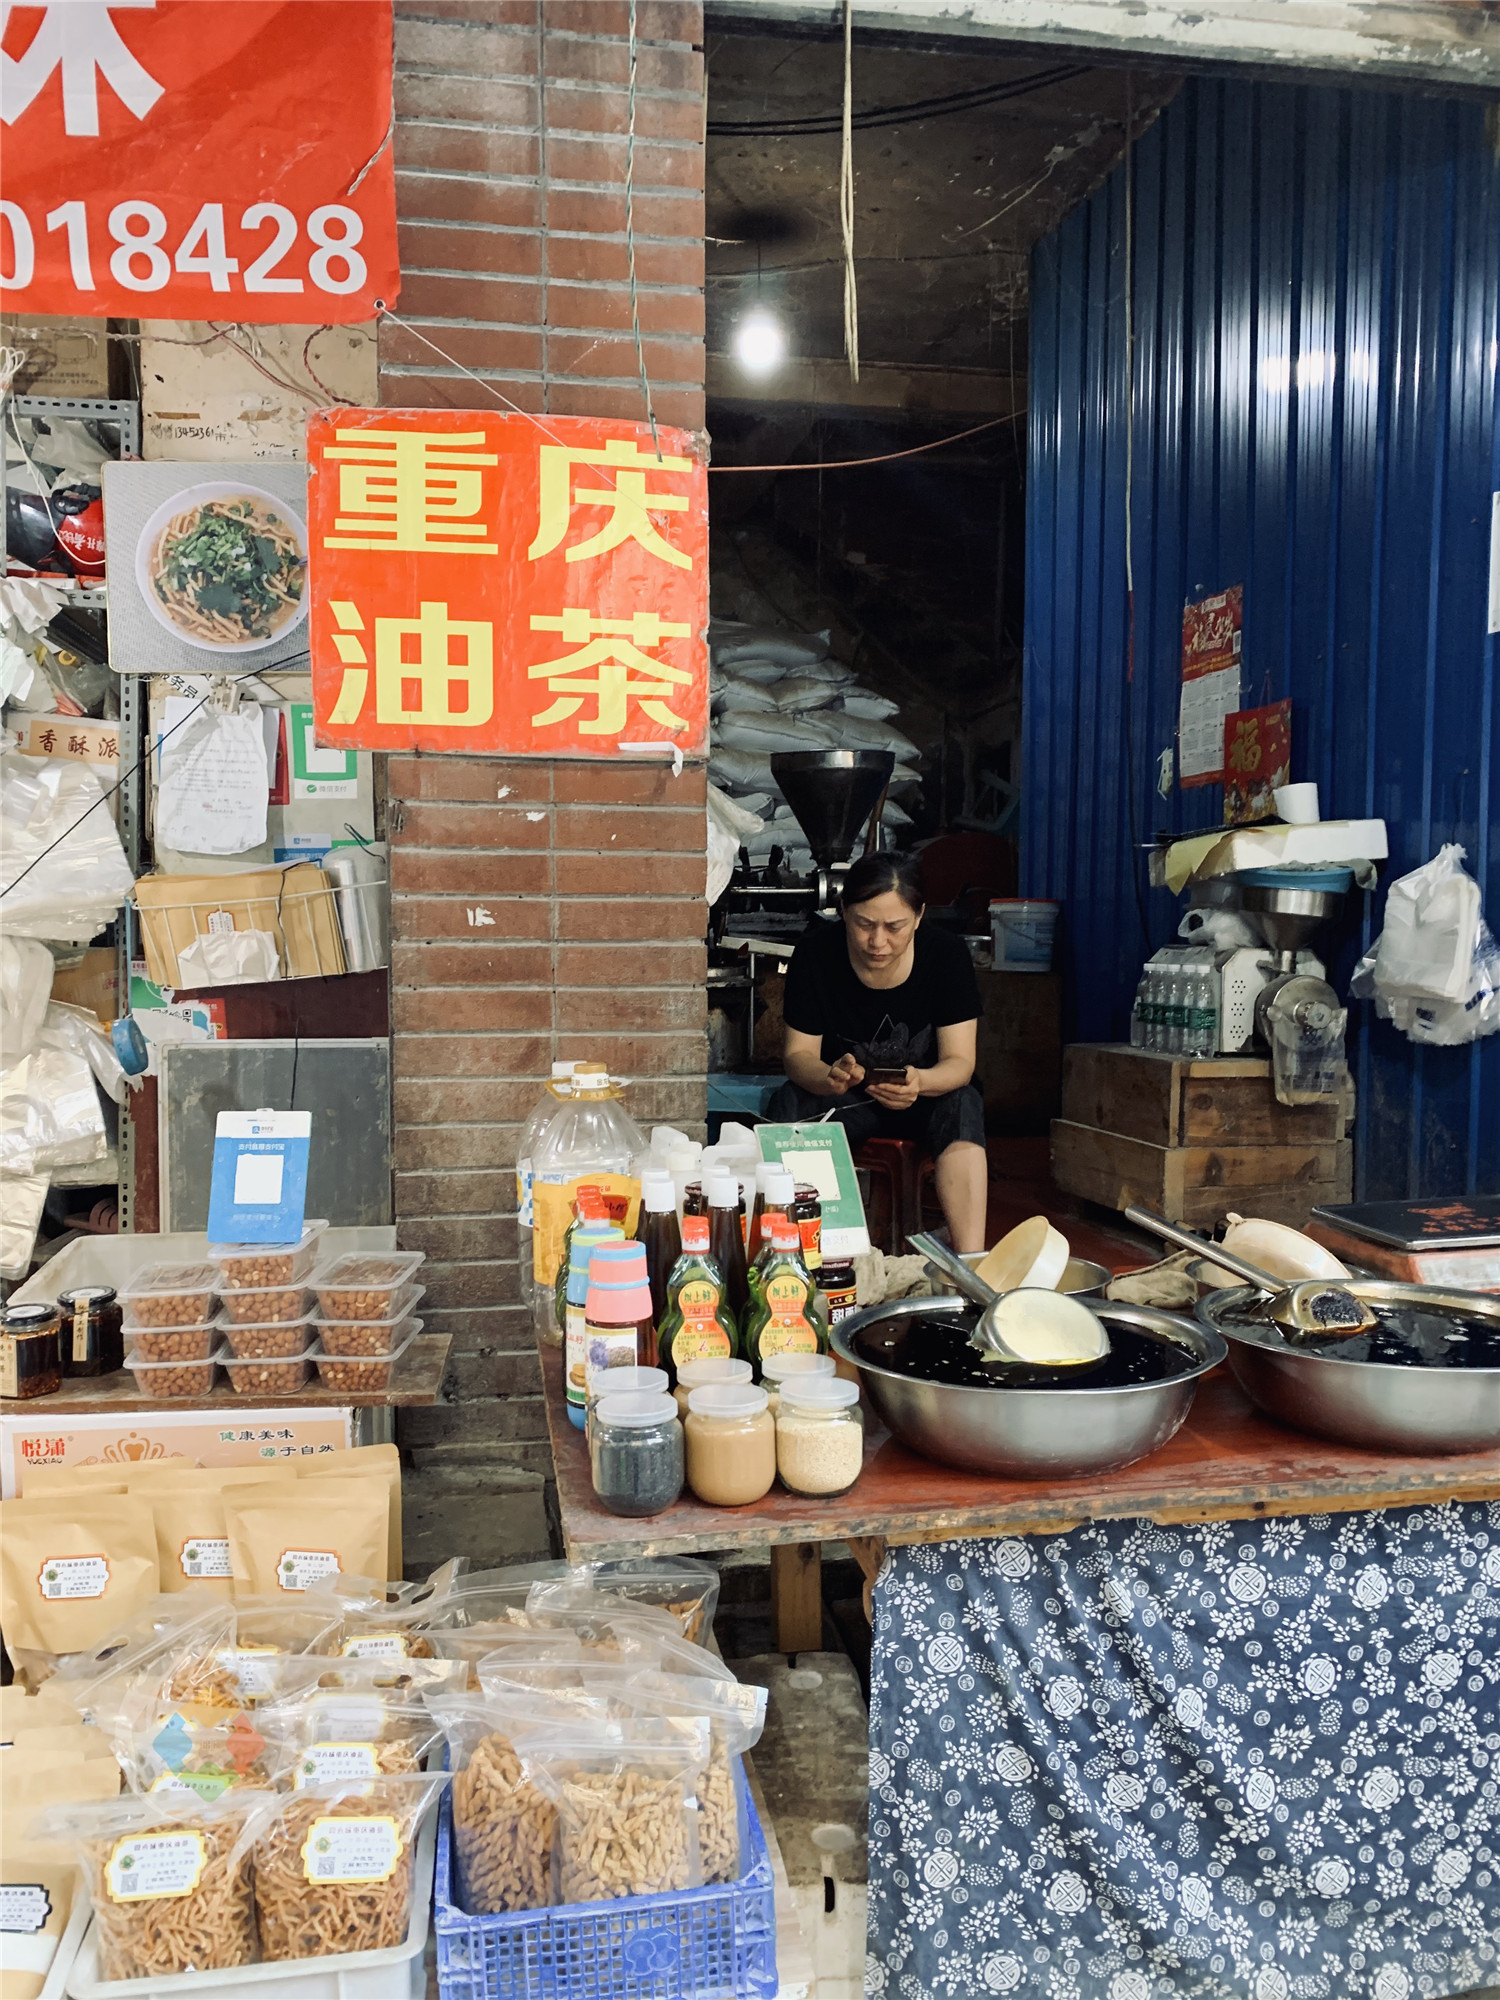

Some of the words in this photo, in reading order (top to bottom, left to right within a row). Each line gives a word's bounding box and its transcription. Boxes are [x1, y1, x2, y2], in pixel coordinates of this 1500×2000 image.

[323, 428, 693, 571] 重庆
[327, 600, 693, 735] 油茶
[39, 728, 120, 758] 香酥派
[1229, 717, 1262, 773] 福
[219, 1428, 294, 1442] 健康美味
[260, 1444, 335, 1458] 源于自然
